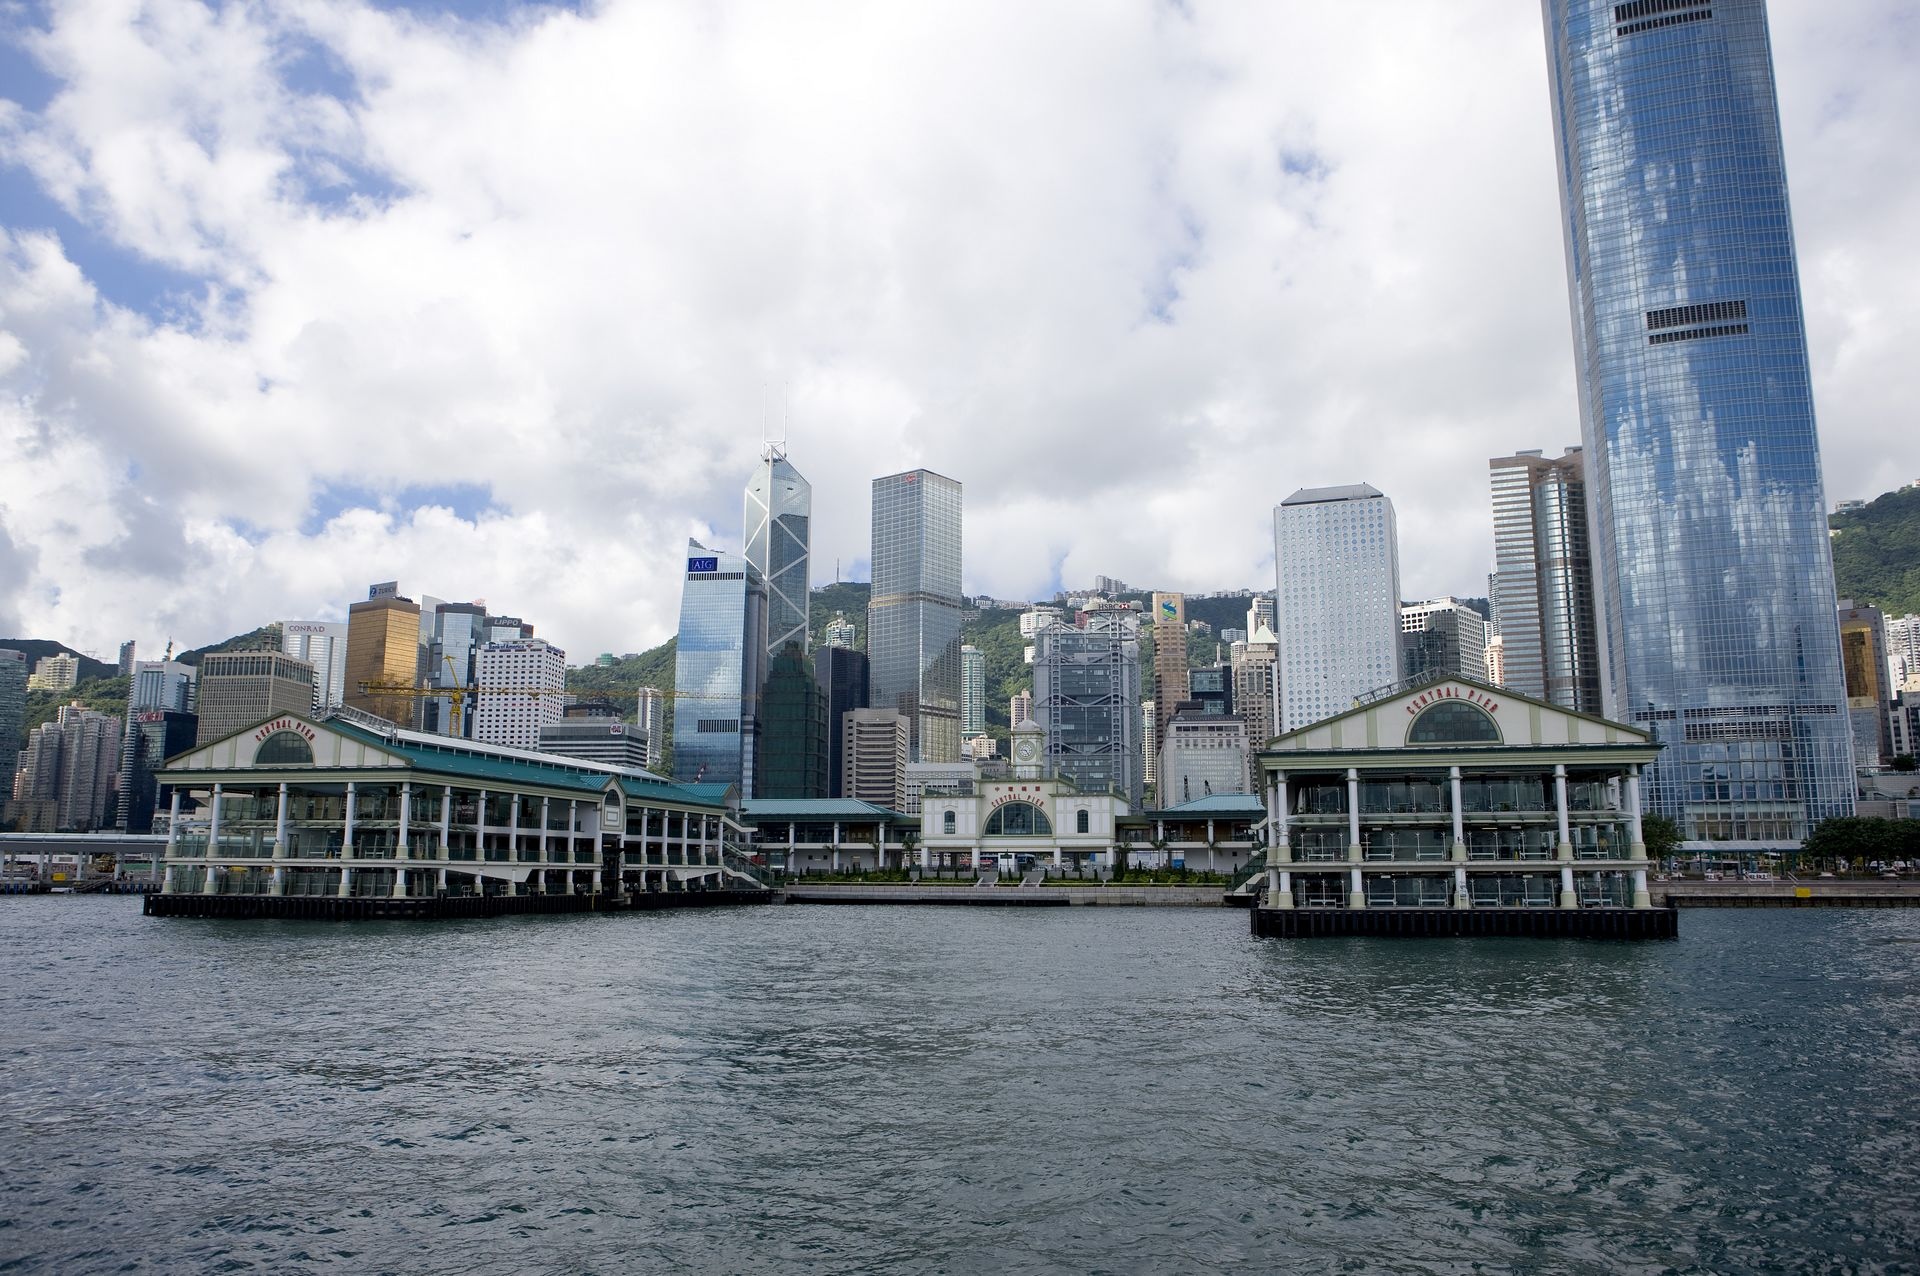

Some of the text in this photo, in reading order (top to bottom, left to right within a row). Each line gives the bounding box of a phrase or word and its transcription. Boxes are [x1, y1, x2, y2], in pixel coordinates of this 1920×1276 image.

[693, 560, 713, 569] AIG
[289, 625, 325, 633] CONRAD
[1406, 687, 1499, 715] CENTRAL PIER
[255, 719, 316, 742] CENTRAL PIER
[991, 793, 1044, 807] CENTRAL PIER
